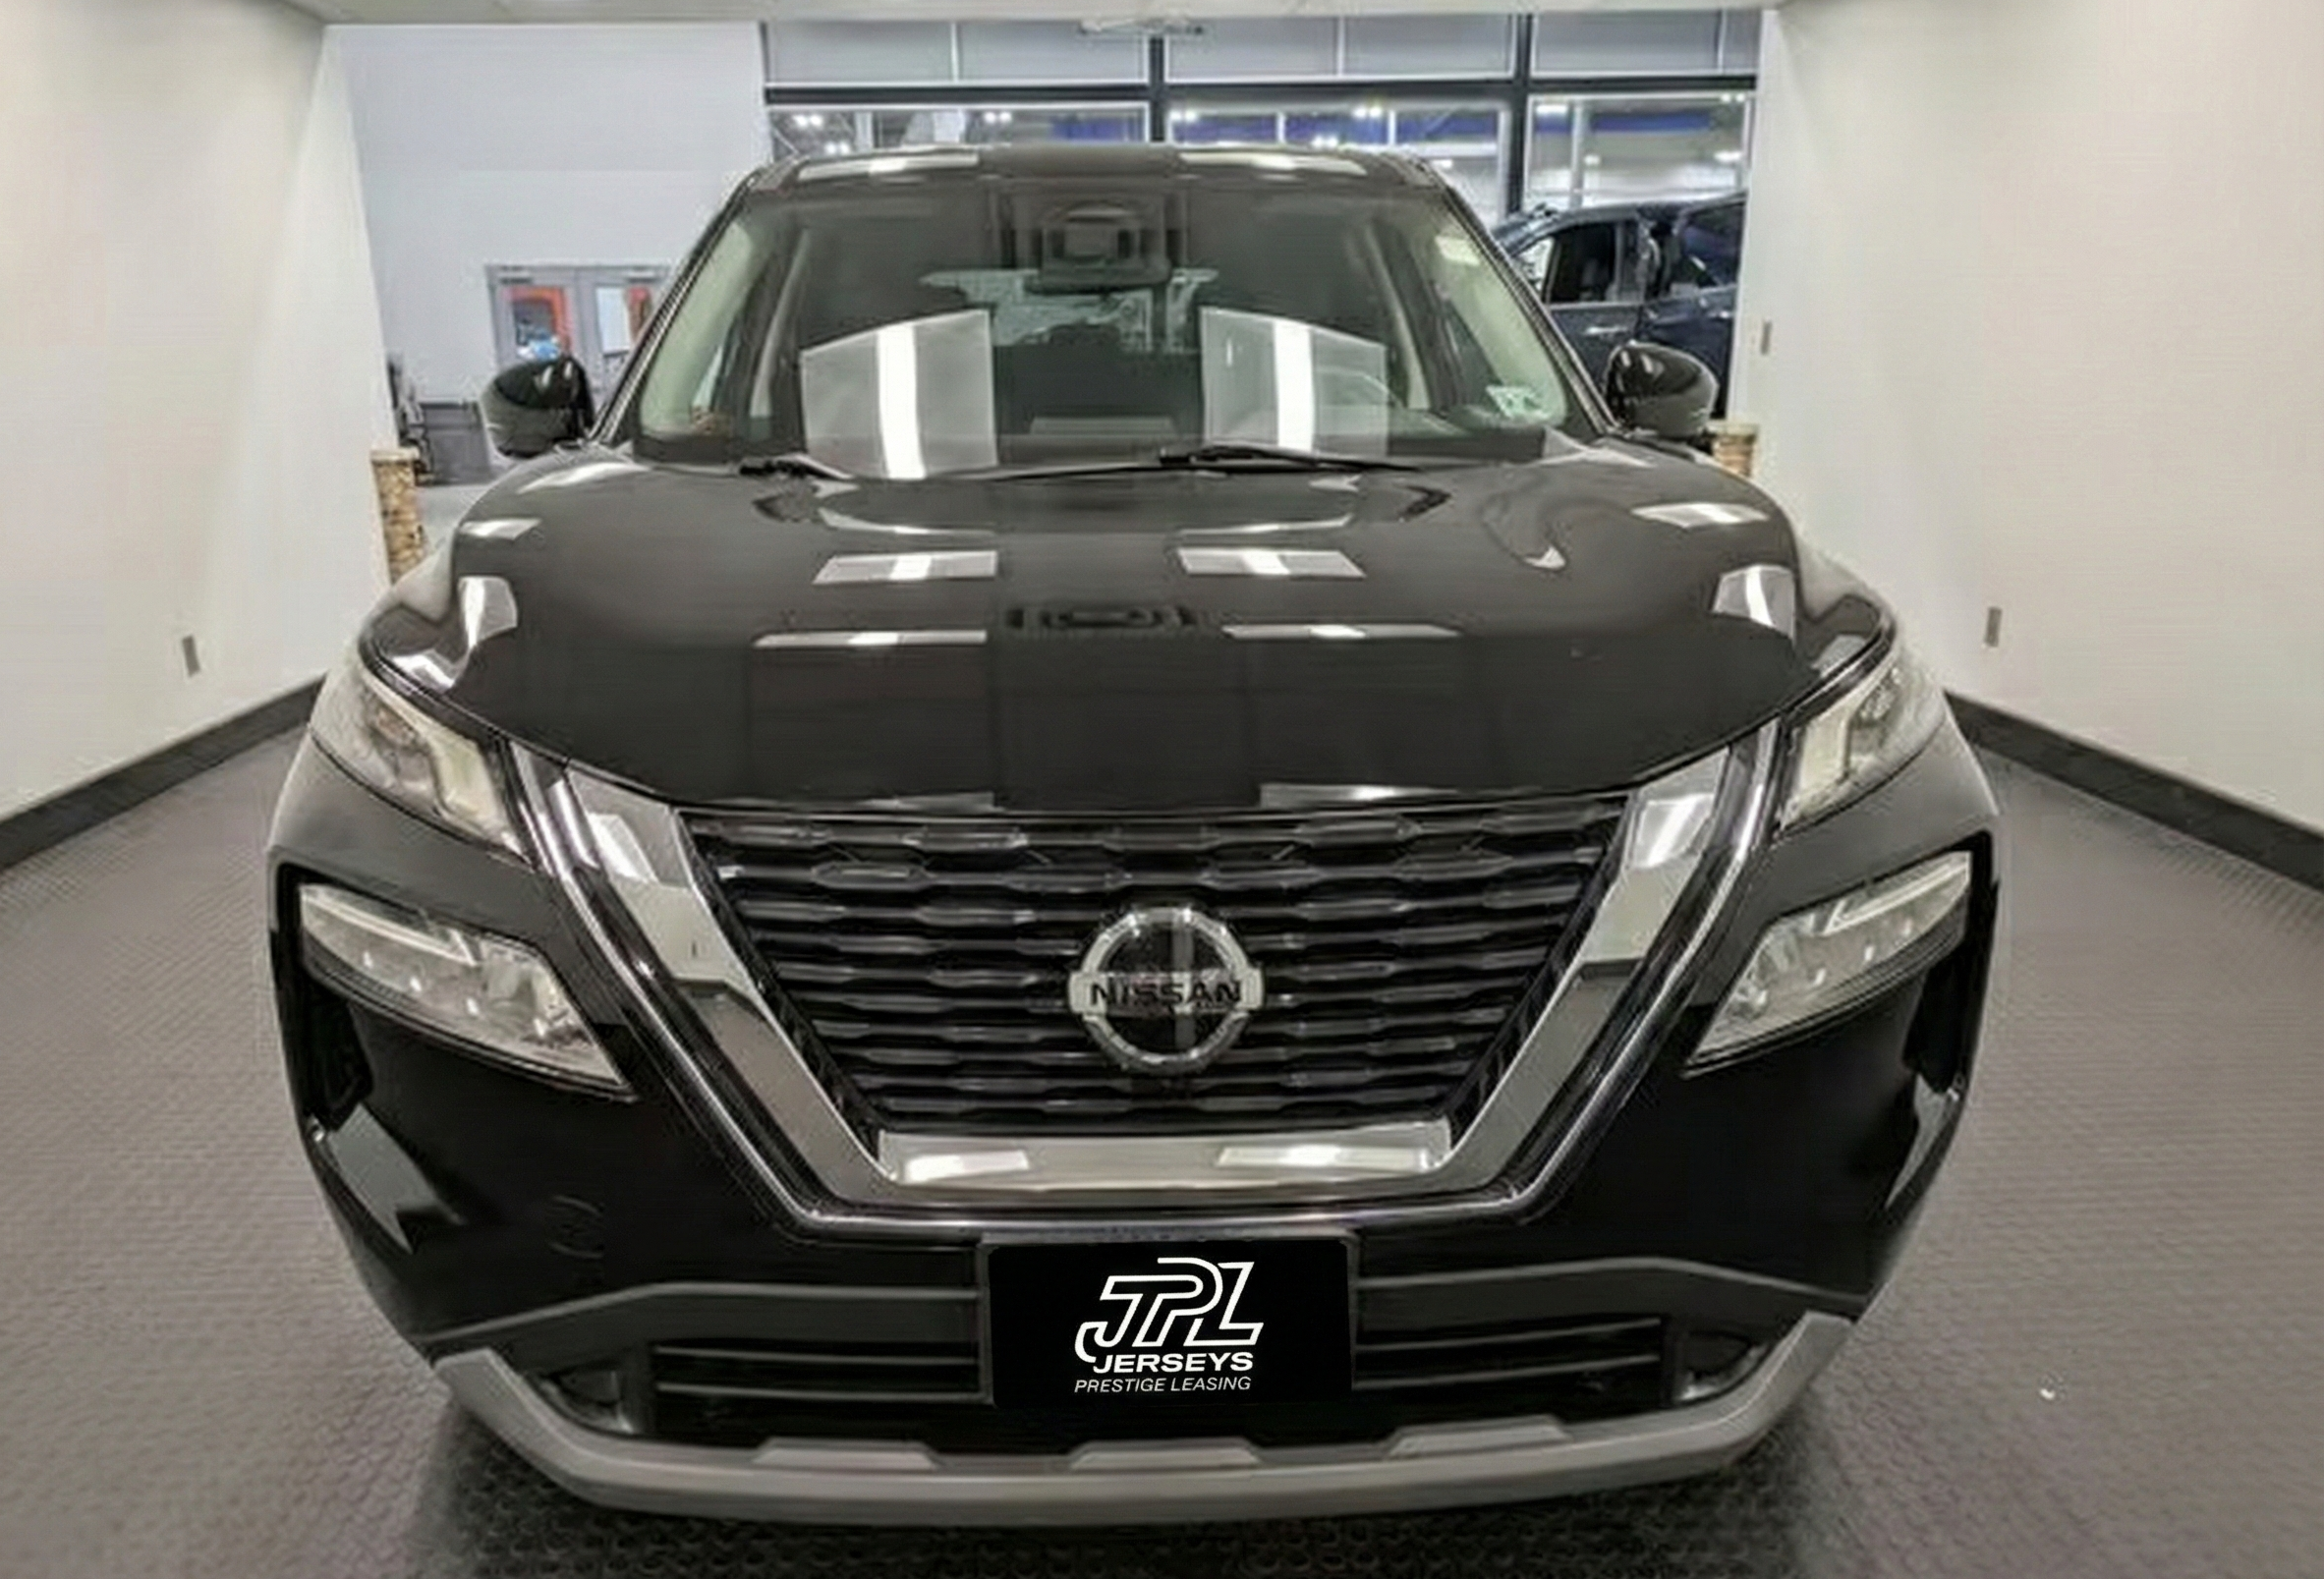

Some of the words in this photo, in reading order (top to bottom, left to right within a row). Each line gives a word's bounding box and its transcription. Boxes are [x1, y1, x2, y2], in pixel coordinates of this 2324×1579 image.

[1090, 980, 1241, 1005] NISSAN
[1074, 1257, 1265, 1364] JPL
[1092, 1351, 1254, 1375] JERSEYS
[1074, 1378, 1167, 1393] PRESTIGE
[1169, 1376, 1252, 1392] LEASING
